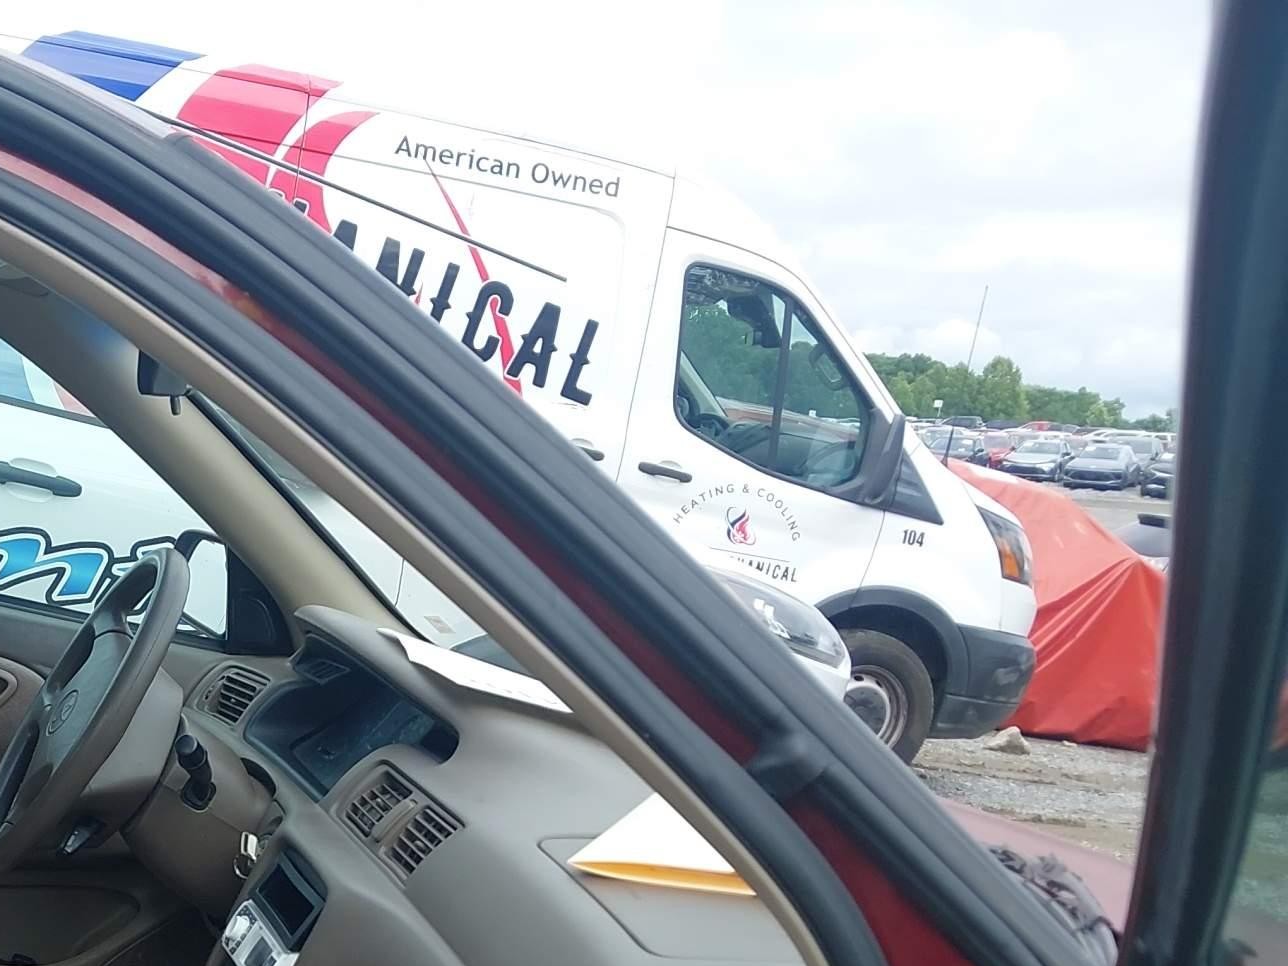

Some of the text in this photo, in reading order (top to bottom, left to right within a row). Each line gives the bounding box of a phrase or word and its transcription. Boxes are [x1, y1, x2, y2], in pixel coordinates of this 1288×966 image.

[395, 135, 621, 198] American Owned
[673, 483, 801, 542] HEATING & COOLING
[902, 529, 925, 547] 104
